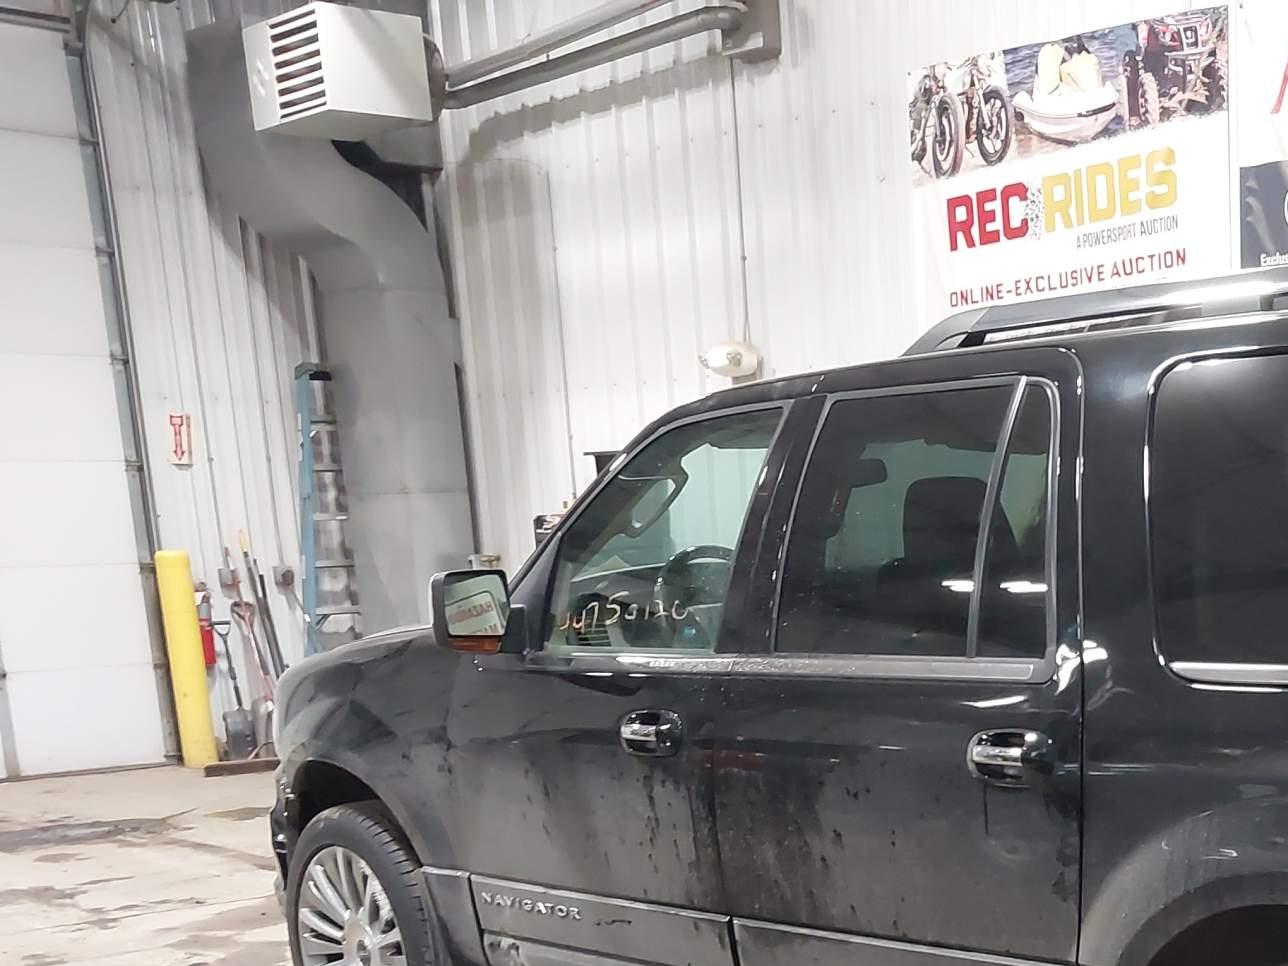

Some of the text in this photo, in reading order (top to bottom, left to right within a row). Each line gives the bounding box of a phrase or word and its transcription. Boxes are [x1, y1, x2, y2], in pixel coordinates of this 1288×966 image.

[946, 147, 1178, 252] REC RIDES
[1082, 222, 1137, 249] POWERSPORT
[1140, 214, 1179, 237] AUCTION
[949, 248, 1186, 308] ONLINE-EXCLUSIVE AUCTION
[481, 891, 582, 921] NAVIGATOR
